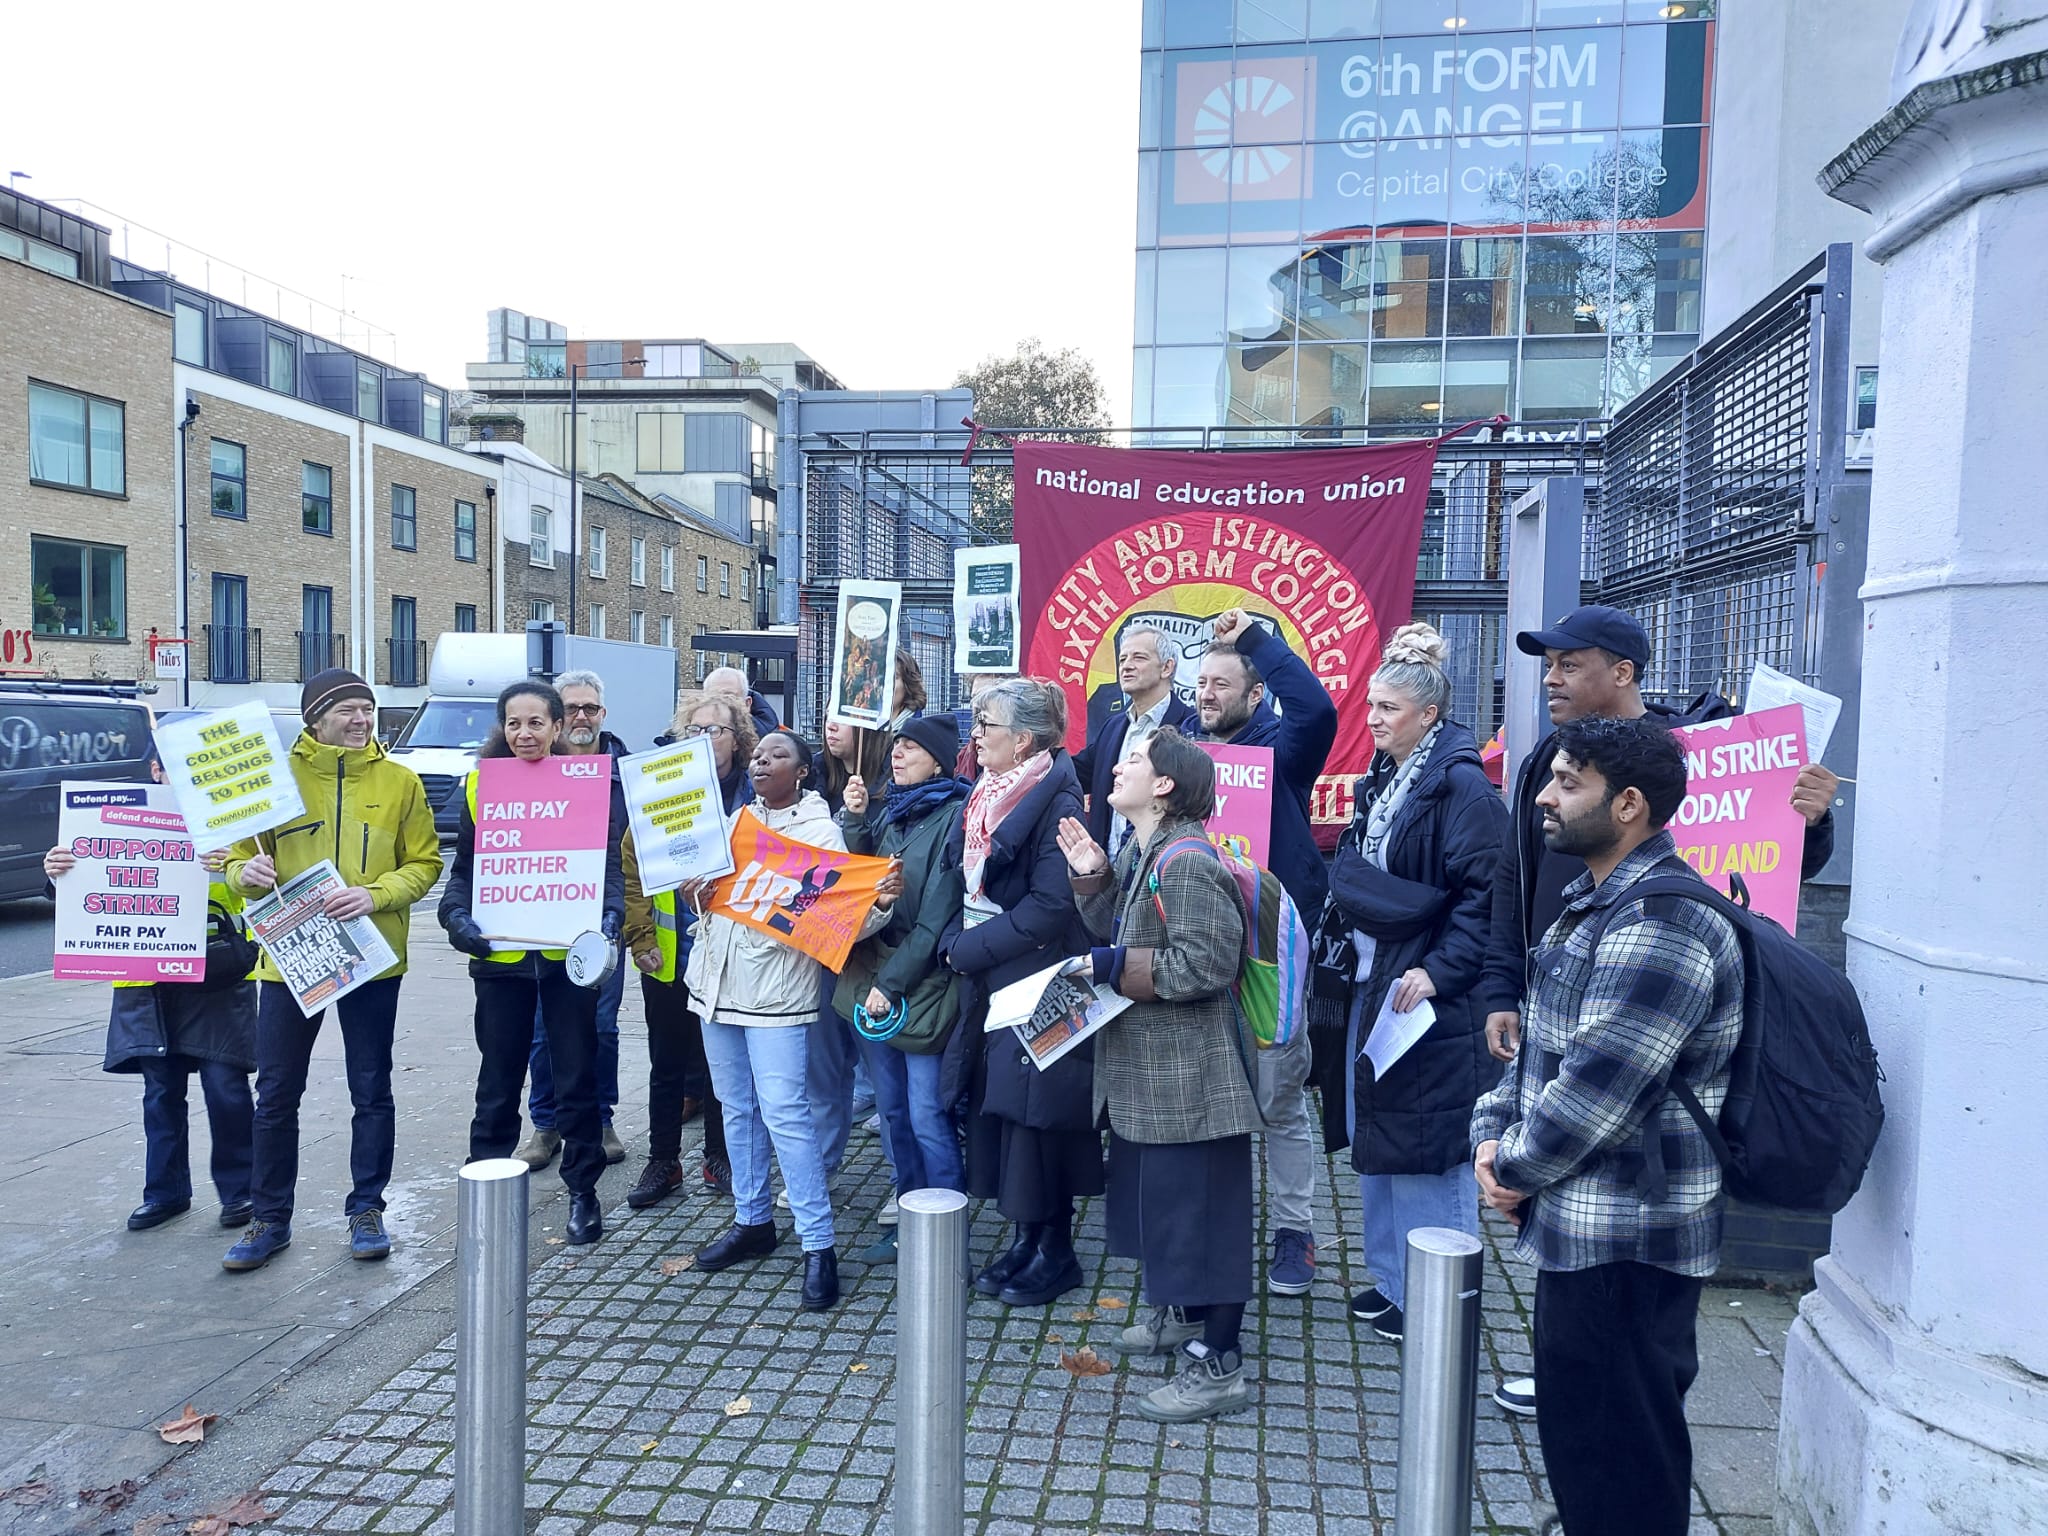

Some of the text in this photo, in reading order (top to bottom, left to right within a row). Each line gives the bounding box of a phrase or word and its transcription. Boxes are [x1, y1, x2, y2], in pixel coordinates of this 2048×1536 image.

[1340, 43, 1598, 98] 6th FORM
[1338, 100, 1605, 159] @ANGEL
[1337, 162, 1668, 201] Capital City College
[1035, 467, 1406, 507] national education union
[1047, 517, 1370, 634] CITY AND ISLINGTON
[1058, 549, 1348, 691] SIXTH FORM COLLEGE
[0, 629, 33, 664] O'S
[198, 721, 239, 743] THE
[186, 735, 266, 767] COLLEGE
[641, 752, 694, 773] COMMUNITY
[1688, 733, 1800, 780] N STRIKE
[191, 752, 273, 786] BELONGS
[655, 770, 684, 783] NEEDS
[1214, 762, 1267, 789] TRIKE
[73, 795, 136, 804] Defend pay...
[206, 774, 272, 802] TO THE
[206, 801, 271, 828] COMMUNITY
[483, 800, 569, 821] FAIR PAY
[642, 790, 706, 814] SABOTAGED BY
[651, 805, 702, 826] CORPORATE
[106, 810, 186, 828] defend educatio
[665, 821, 694, 835] GREED
[72, 837, 194, 861] SUPPORT
[481, 829, 522, 849] FOR
[480, 856, 568, 876] FURTHER
[753, 829, 850, 888] PAY
[1677, 841, 1780, 876] CU AND
[106, 866, 159, 888] THE
[84, 893, 179, 916] STRIKE
[261, 879, 336, 931] Socialist Worker
[479, 883, 596, 904] EDUCATION
[96, 925, 167, 938] FAIR PAY
[270, 912, 335, 957] LEFT MUS
[65, 940, 197, 951] IN FURTHER EDUCATION
[278, 936, 317, 970] DRIVE
[315, 921, 342, 946] OUT
[286, 938, 343, 981] STARMER
[293, 978, 307, 993] &
[304, 949, 351, 986] REEVES
[1020, 986, 1083, 1040] & REEVES
